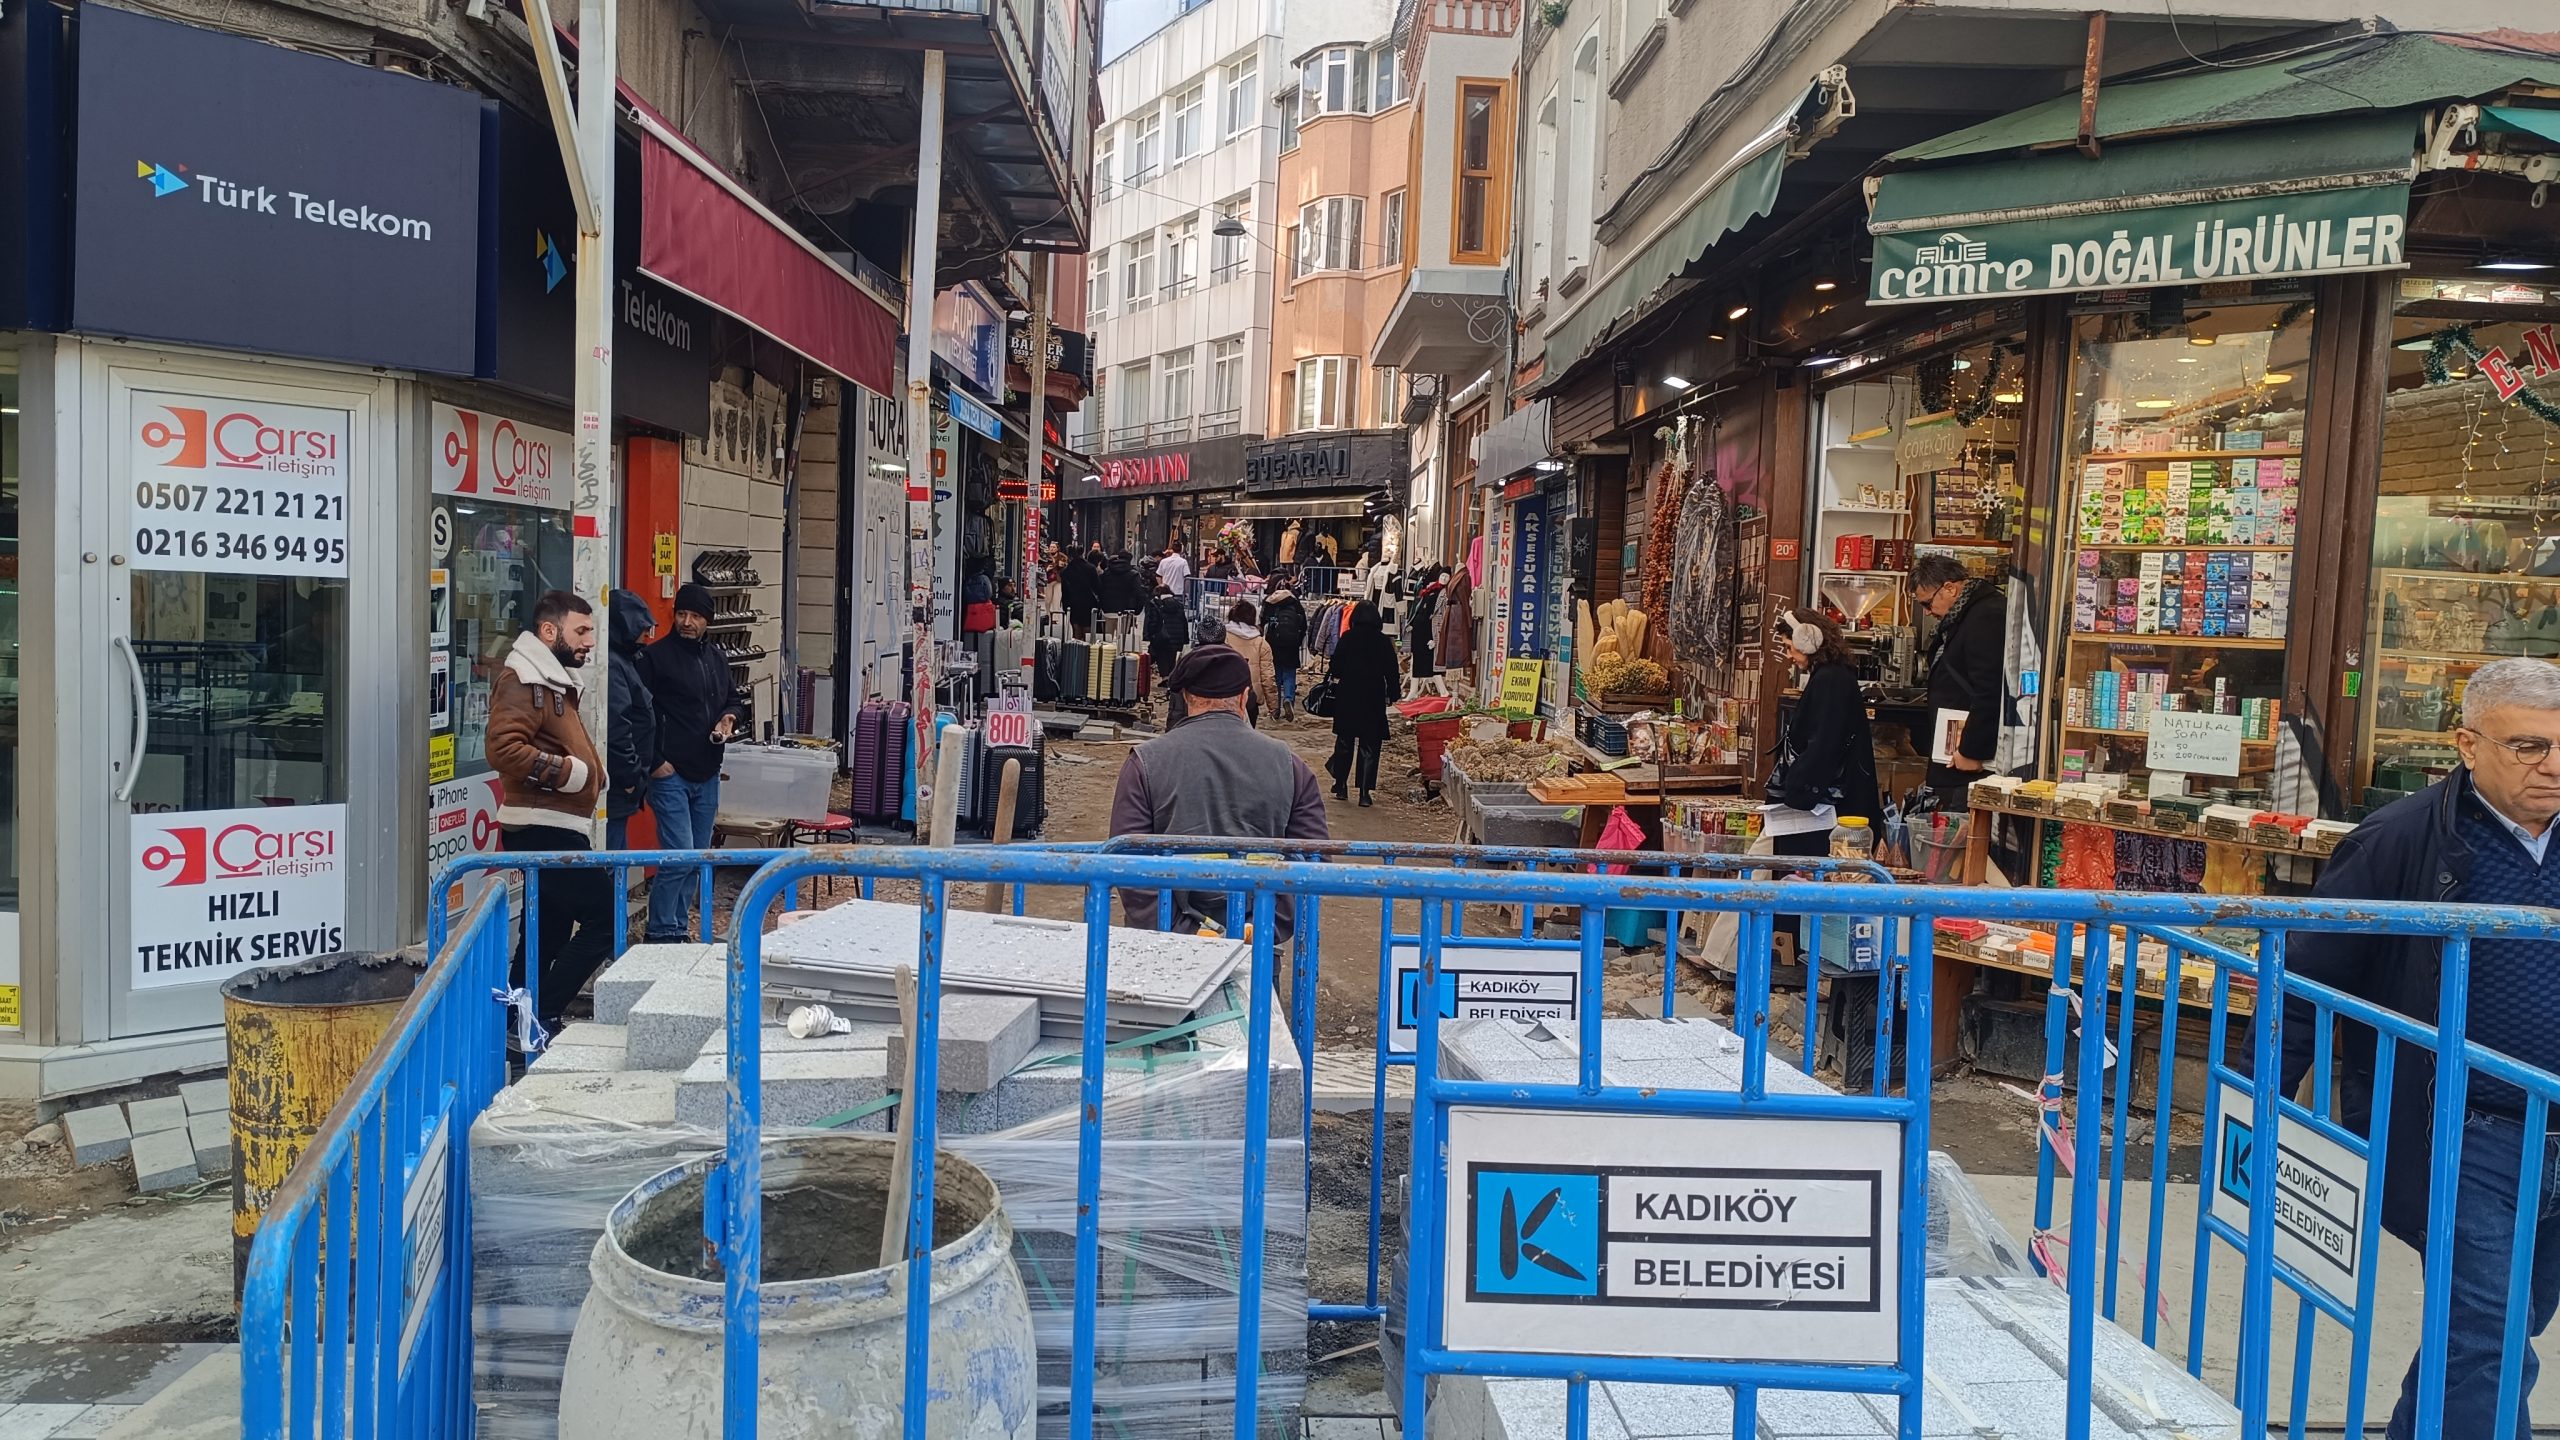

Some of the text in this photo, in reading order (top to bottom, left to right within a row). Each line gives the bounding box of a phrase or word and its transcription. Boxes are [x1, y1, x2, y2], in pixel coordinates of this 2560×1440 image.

[196, 174, 432, 242] Türk Telekom
[1880, 213, 2404, 298] cemre DOĞAL ÜRÜNLER
[621, 279, 691, 352] Telekom
[952, 294, 978, 350] AURA
[268, 456, 335, 479] iletişim
[1102, 452, 1190, 489] ROSSMANN
[136, 481, 343, 521] 0507 221 21 21
[136, 528, 344, 564] 0216 346 94 95
[434, 514, 447, 546] S
[659, 551, 672, 560] SAAT
[1498, 504, 1511, 599] TEKNİK
[1521, 512, 1540, 594] AKSESUAR
[658, 565, 673, 574] ALINIR
[1509, 661, 1538, 673] KIRILMAZ
[1511, 676, 1532, 687] EKRAN
[1503, 690, 1534, 703] KORUYUCU
[2164, 716, 2231, 732] NATURAL
[2173, 729, 2207, 739] SOAP
[437, 786, 468, 808] iPhone
[440, 811, 466, 829] ONEPLUS
[266, 858, 334, 878] iletişim
[208, 890, 280, 922] HIZLI
[139, 921, 343, 973] TEKNİK SERVİS
[1470, 979, 1541, 994] KADIKÖY
[2275, 1160, 2330, 1203] KADIKÖY
[1634, 1188, 1798, 1224] KADIKÖY
[2273, 1197, 2344, 1255] BELEDİYESİ
[1633, 1254, 1846, 1291] BELEDİYESİ
